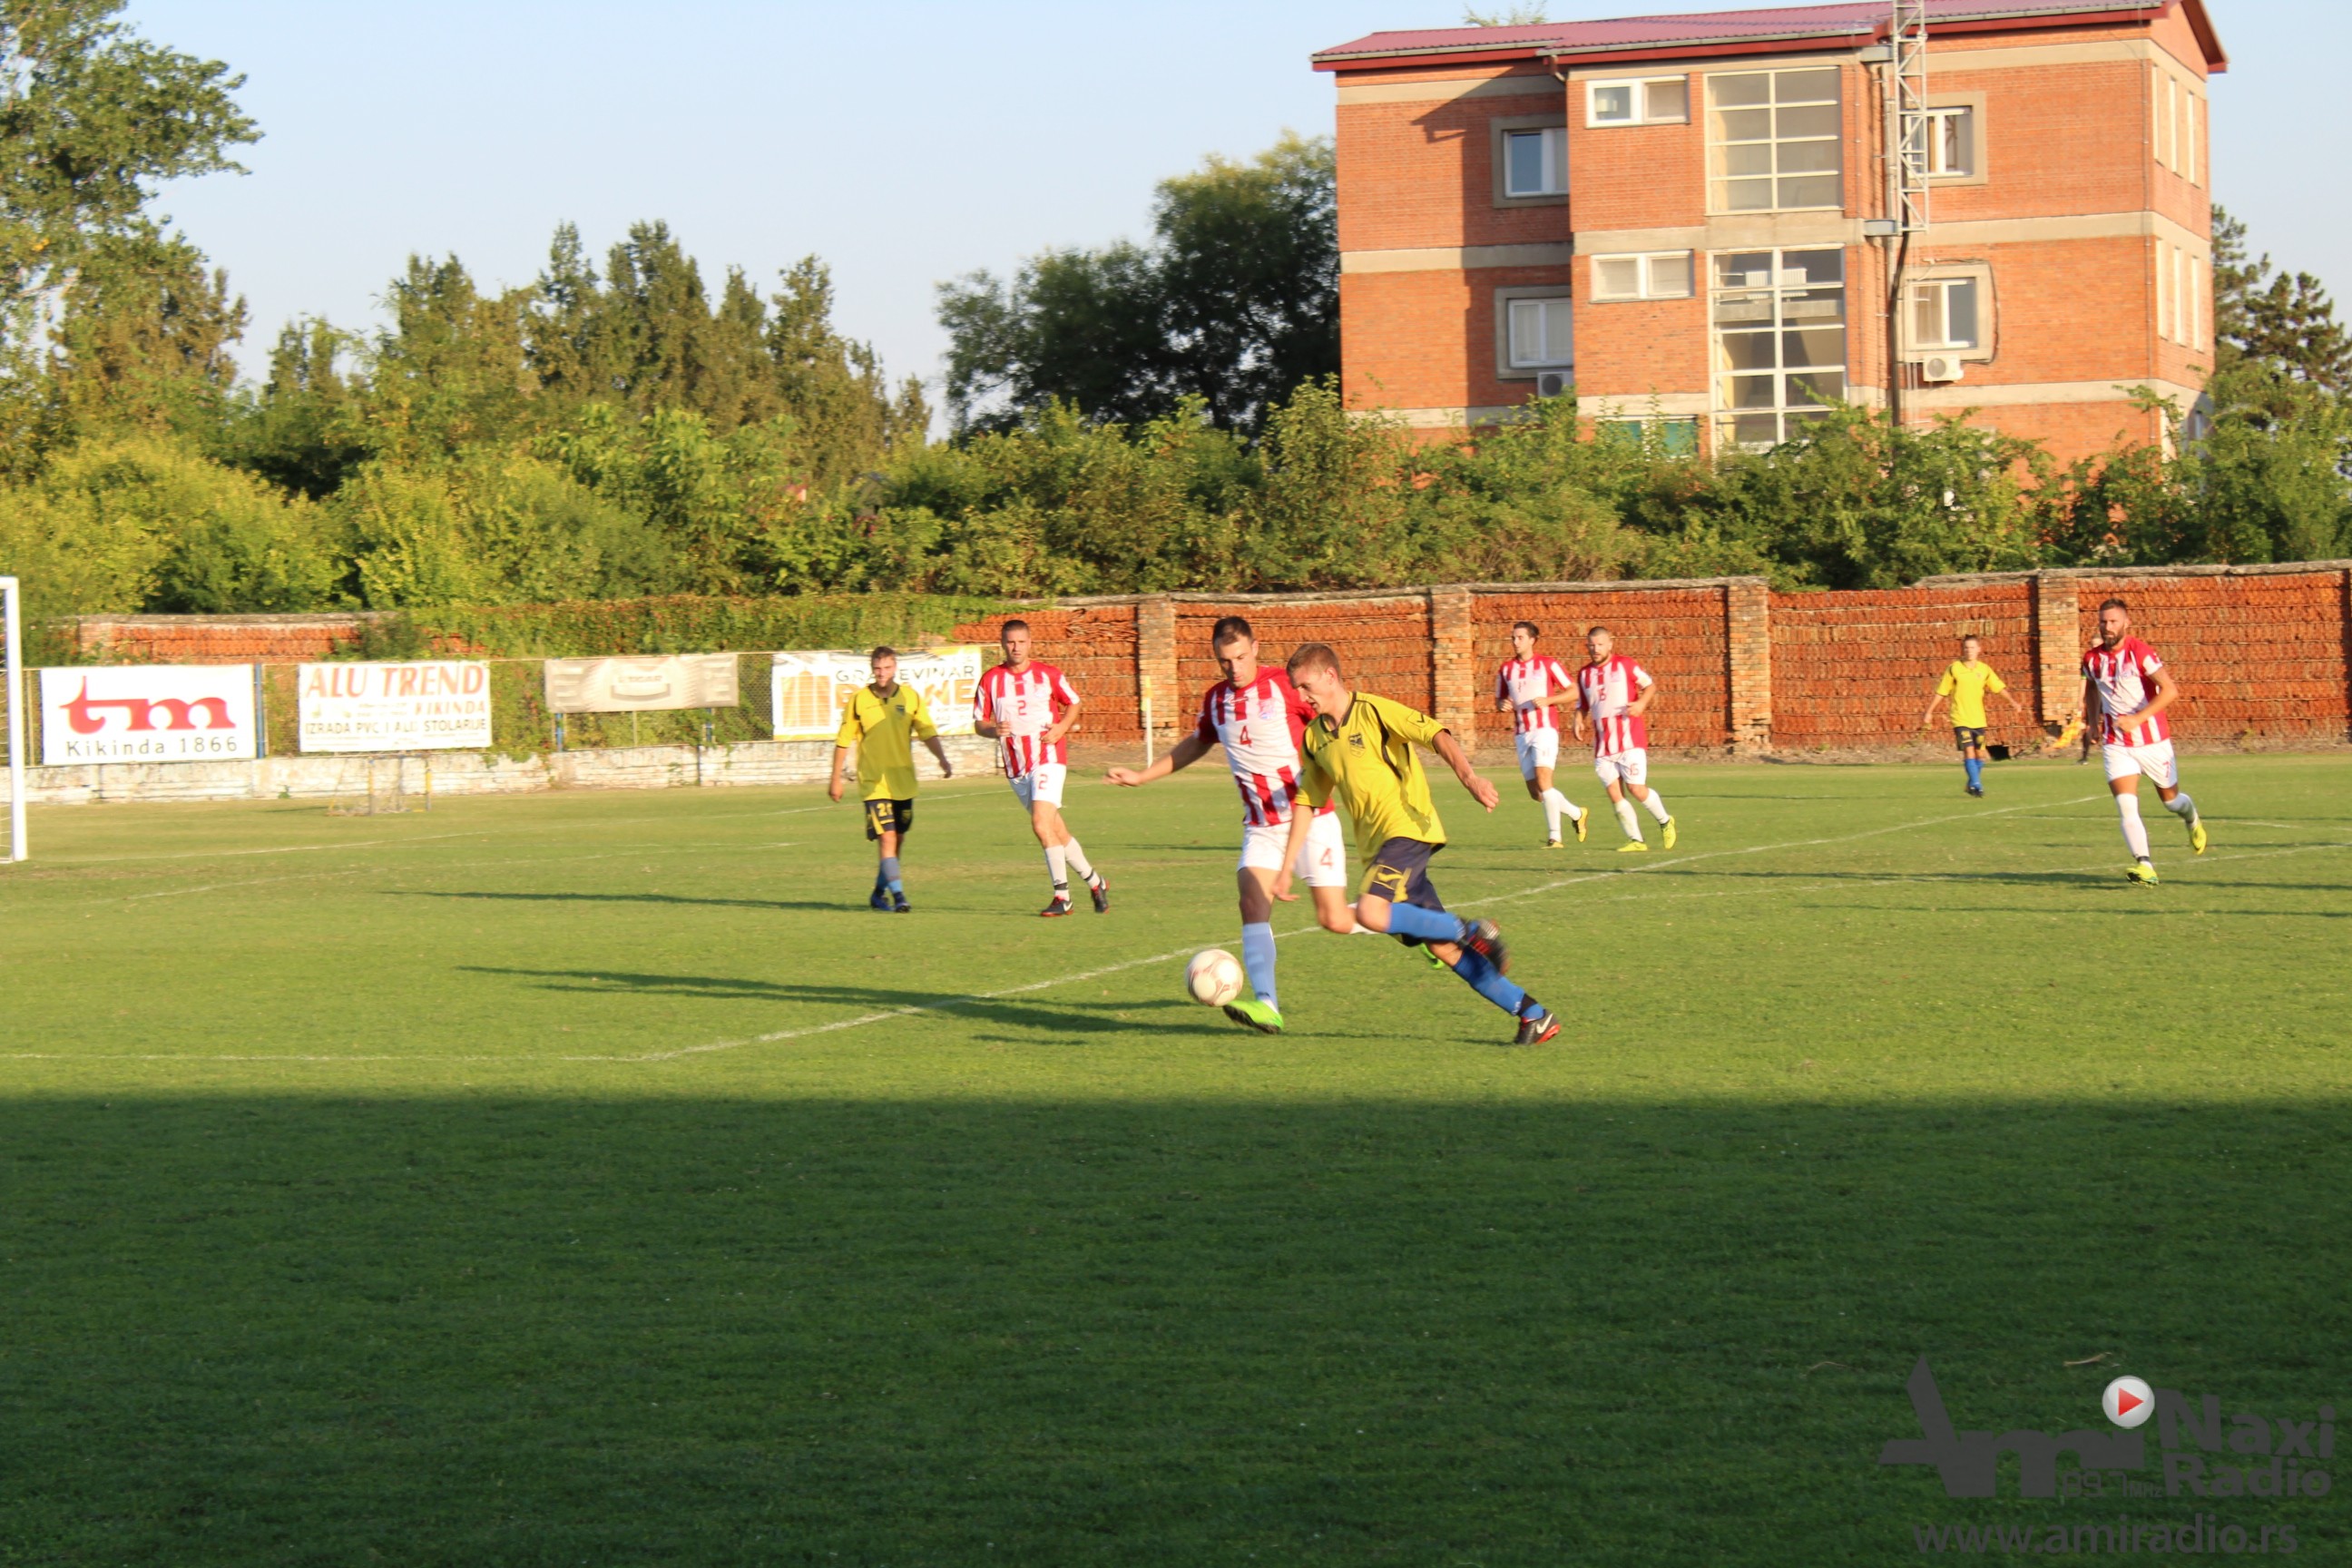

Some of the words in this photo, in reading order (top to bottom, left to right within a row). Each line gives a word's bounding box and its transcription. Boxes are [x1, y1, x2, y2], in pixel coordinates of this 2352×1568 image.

[306, 667, 368, 698] ALU
[381, 664, 484, 697] TREND
[836, 665, 975, 683] GRAEVINAR
[414, 700, 486, 716] KIKINDA
[1017, 700, 1027, 716] 2
[305, 722, 351, 735] IZRADA
[1240, 725, 1251, 747] 4
[66, 739, 165, 757] Kikinda
[180, 736, 238, 753] 1866
[1038, 774, 1048, 790] 2
[1320, 847, 1333, 867] 4
